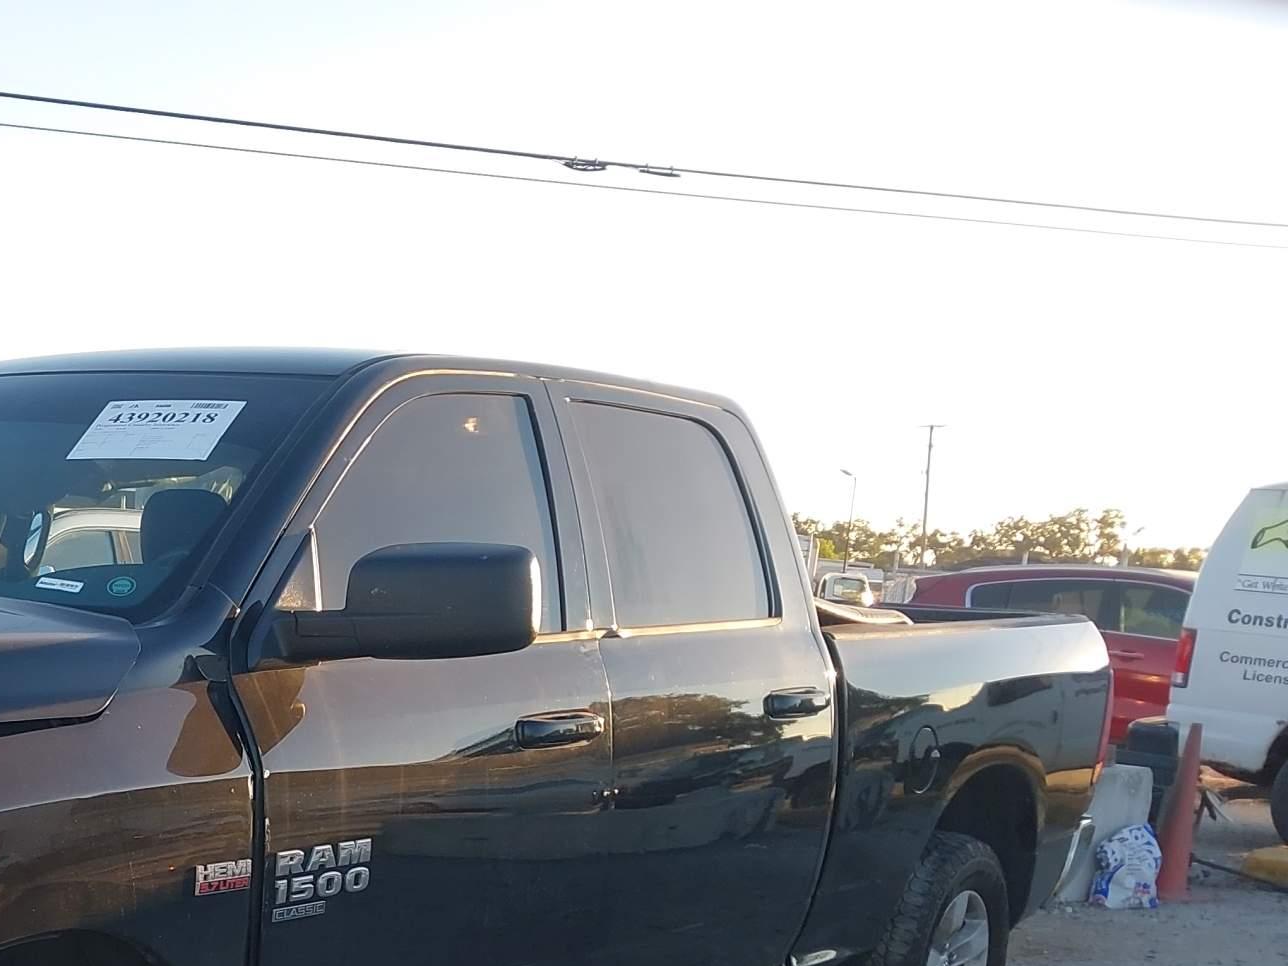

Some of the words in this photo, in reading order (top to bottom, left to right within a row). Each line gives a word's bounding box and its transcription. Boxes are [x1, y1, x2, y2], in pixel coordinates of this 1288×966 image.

[108, 412, 219, 424] 43920218
[275, 838, 372, 876] RAM
[196, 859, 252, 881] HEMI
[199, 879, 218, 894] 5.7
[219, 876, 249, 891] LITER
[274, 866, 370, 904] 1500
[275, 903, 325, 920] CLASSIC
